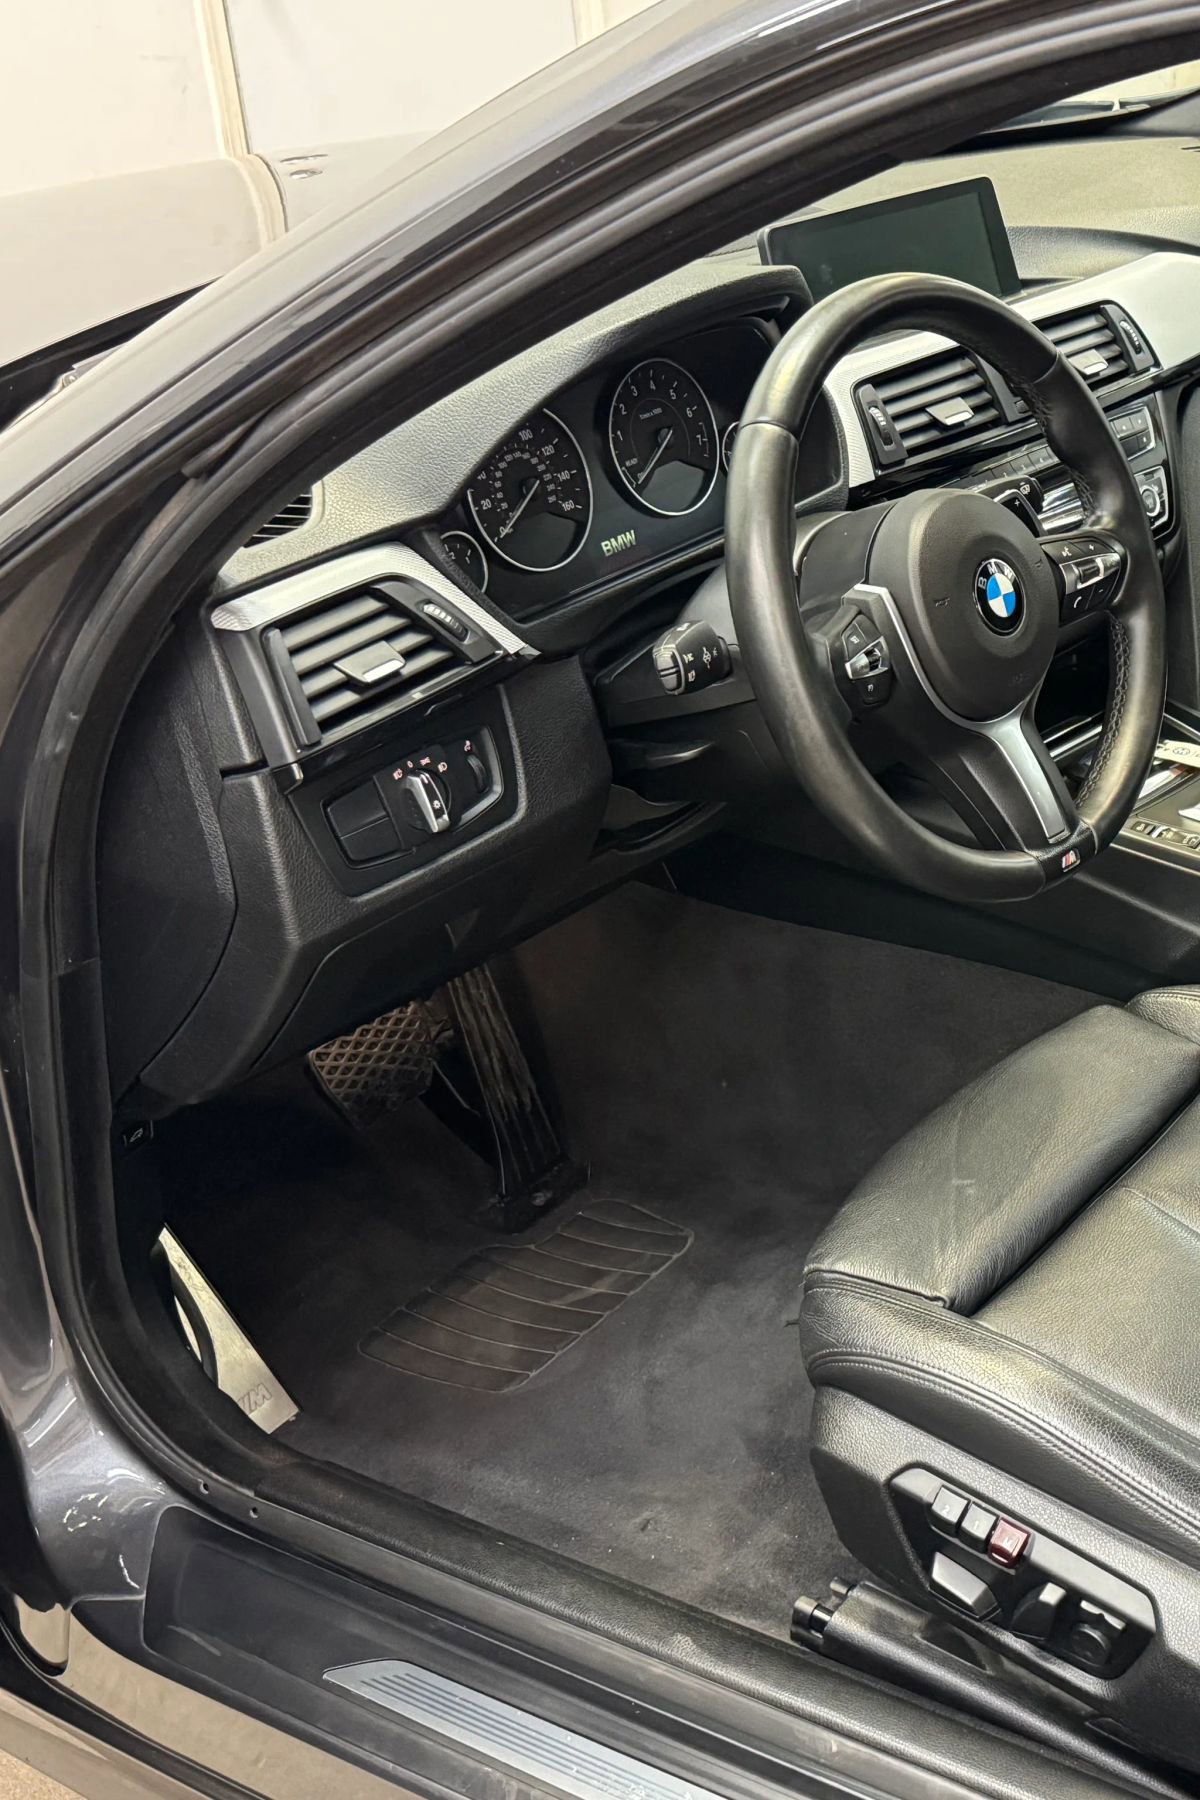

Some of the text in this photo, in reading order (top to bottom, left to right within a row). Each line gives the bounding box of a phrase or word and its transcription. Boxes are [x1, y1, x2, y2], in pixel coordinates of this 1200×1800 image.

[631, 385, 638, 397] 3
[650, 379, 656, 391] 4
[669, 388, 677, 400] 5
[619, 403, 627, 415] 2
[686, 407, 693, 418] 6
[518, 429, 533, 440] 100
[617, 429, 623, 441] 1
[696, 434, 702, 446] 7
[542, 445, 555, 456] 120
[558, 470, 570, 481] 140
[480, 499, 492, 511] 20
[562, 500, 575, 511] 160
[600, 529, 636, 557] BMW
[978, 561, 1016, 590] BMW
[941, 1503, 950, 1516] 2
[973, 1520, 979, 1530] 1
